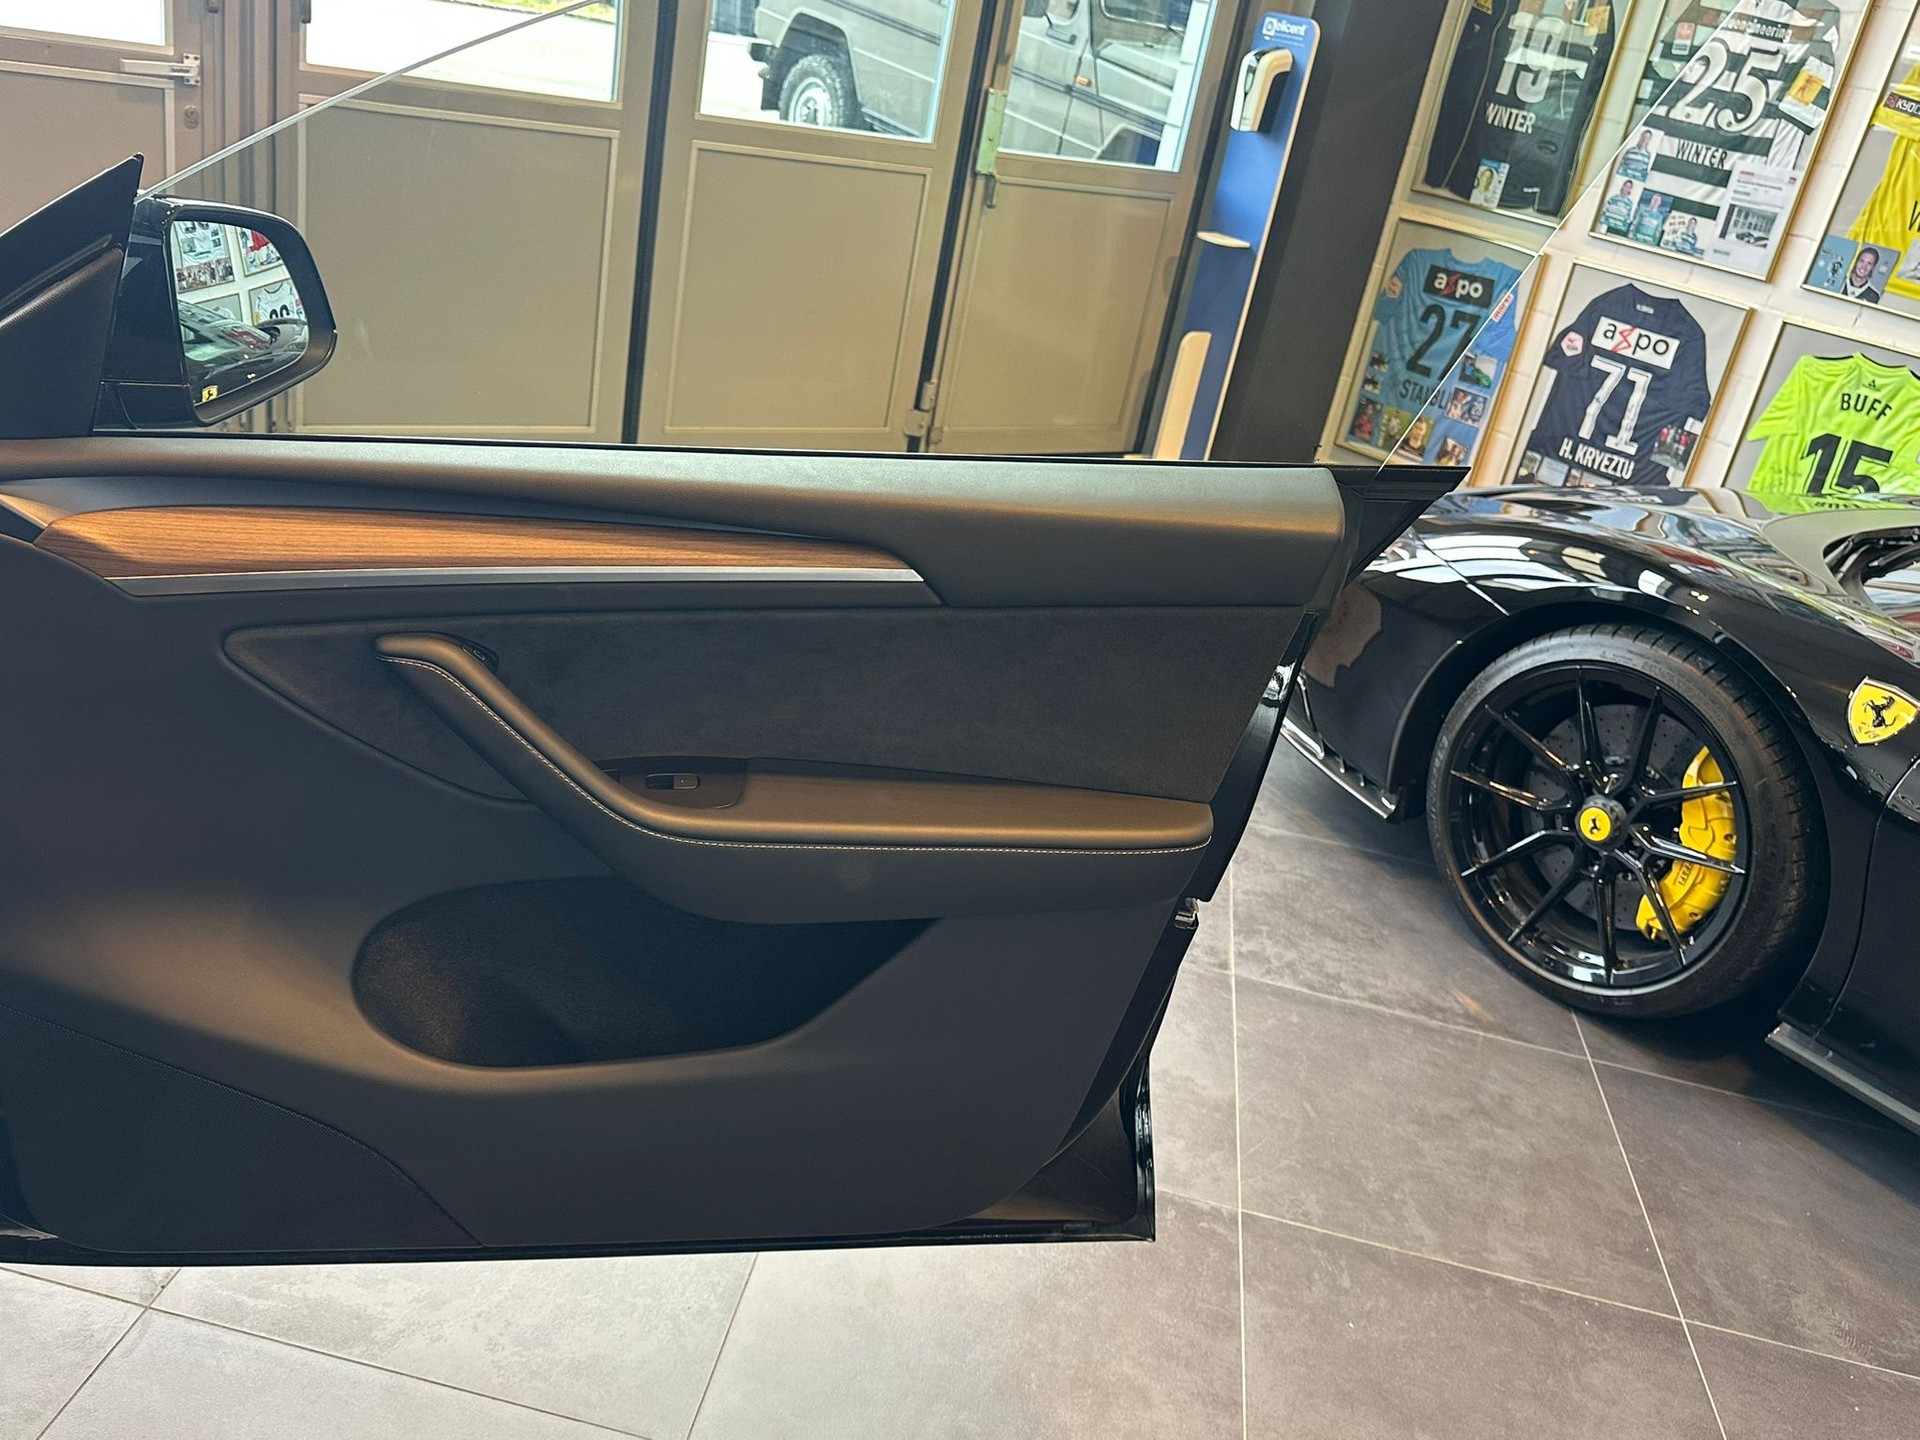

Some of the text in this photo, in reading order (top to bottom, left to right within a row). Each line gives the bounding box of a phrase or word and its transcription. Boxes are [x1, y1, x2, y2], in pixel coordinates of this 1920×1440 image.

[1668, 37, 1780, 134] 25
[1486, 103, 1536, 134] WINTER
[1677, 139, 1728, 169] WINTER
[1405, 303, 1481, 381] 27
[1578, 355, 1652, 455] 71
[1840, 393, 1892, 421] BUFF
[1558, 437, 1635, 480] H. KRYEZIU
[1800, 433, 1893, 496] 15
